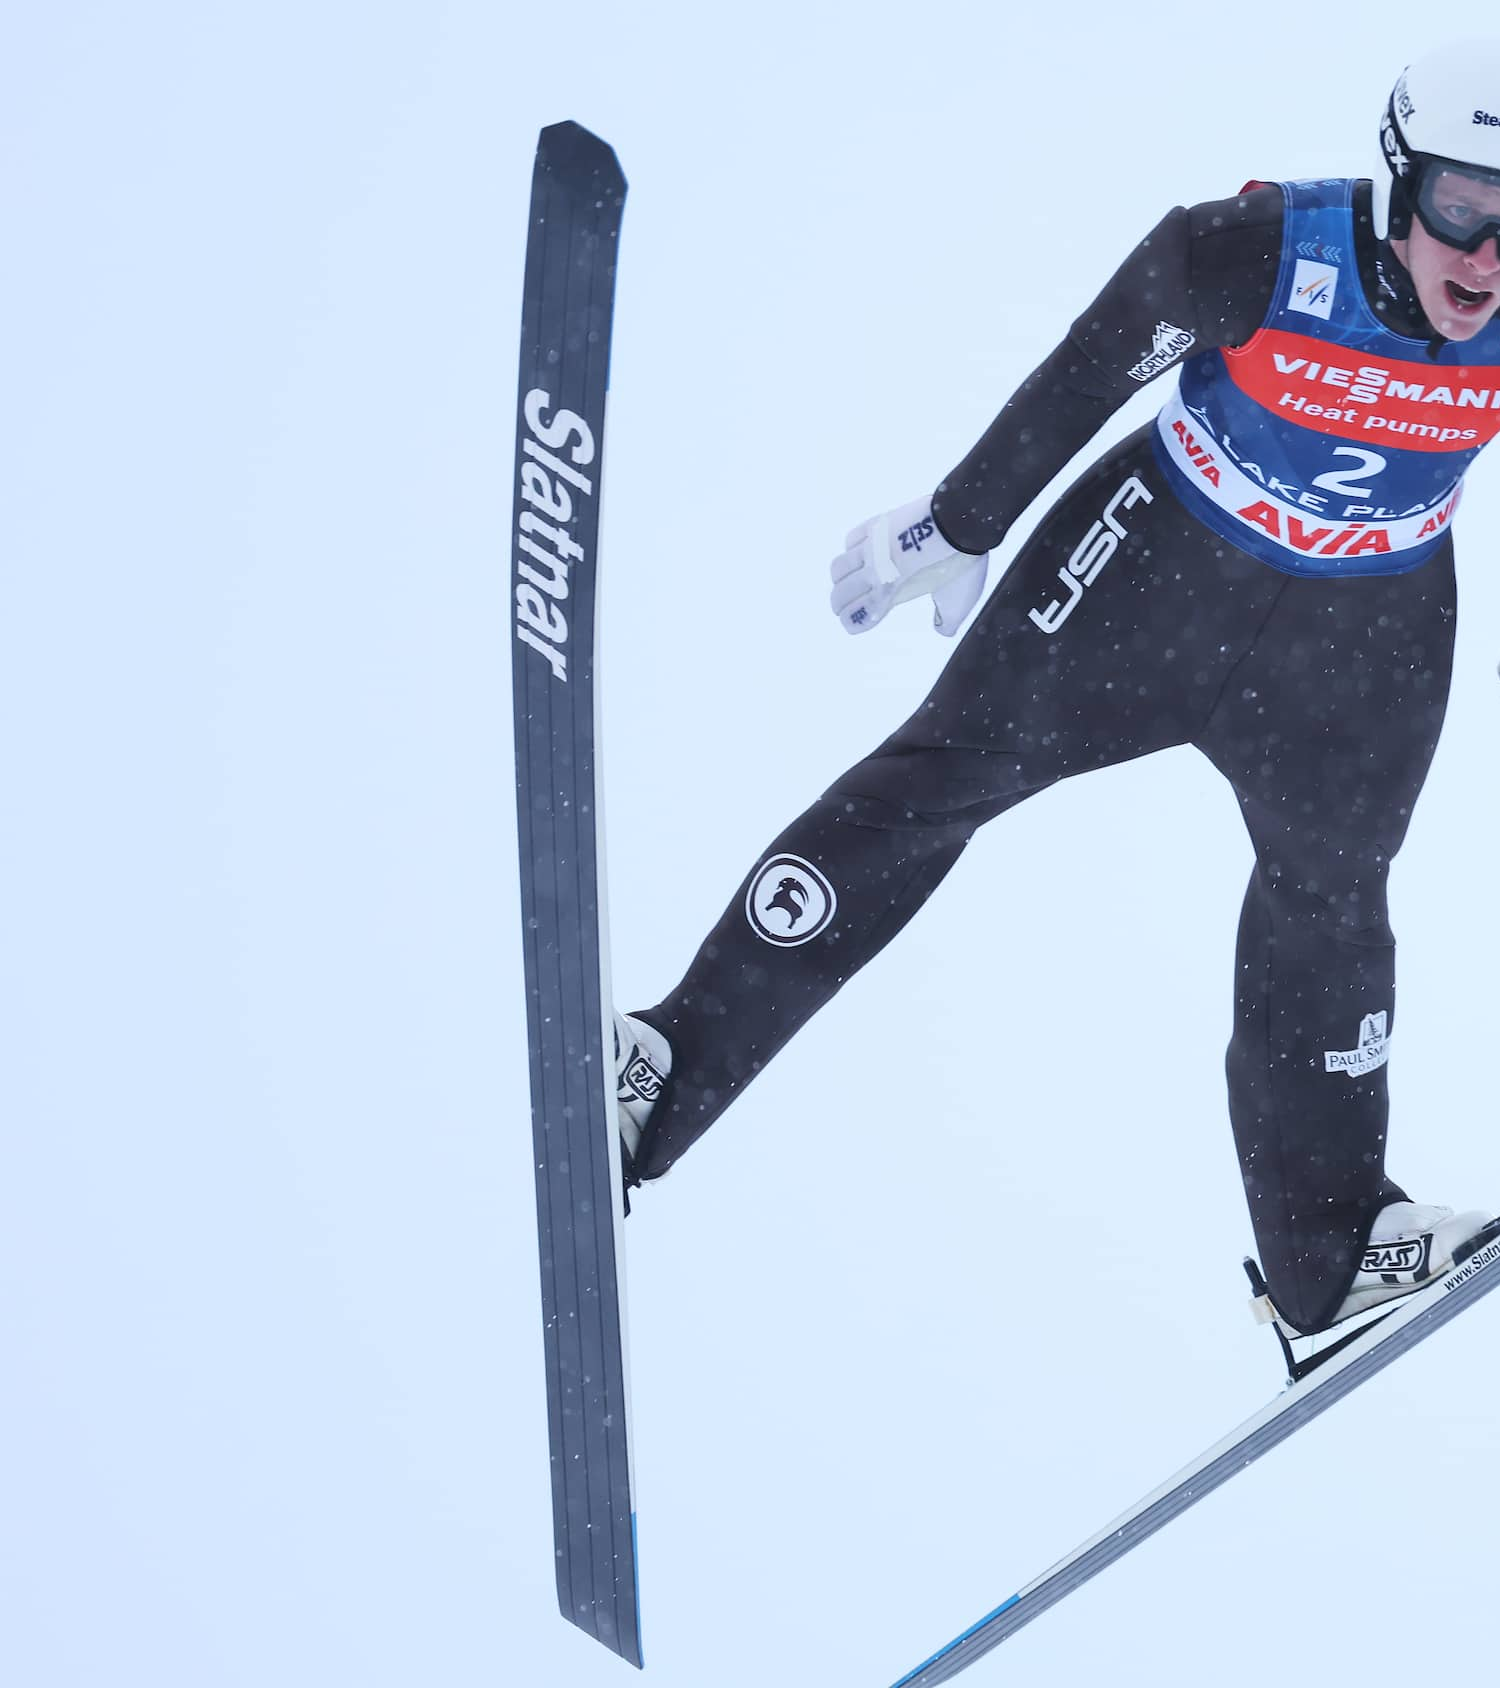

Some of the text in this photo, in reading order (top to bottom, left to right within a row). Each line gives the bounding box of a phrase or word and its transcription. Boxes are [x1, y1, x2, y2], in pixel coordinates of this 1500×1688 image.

[1128, 331, 1192, 380] NORTHLAND
[1278, 392, 1479, 443] Heat pumps
[1222, 435, 1329, 512] LAKE
[1312, 446, 1387, 499] 2
[516, 388, 595, 683] Slatnar
[1028, 477, 1154, 634] USA
[1329, 1053, 1364, 1068] PAUL
[1364, 1245, 1416, 1268] RAST
